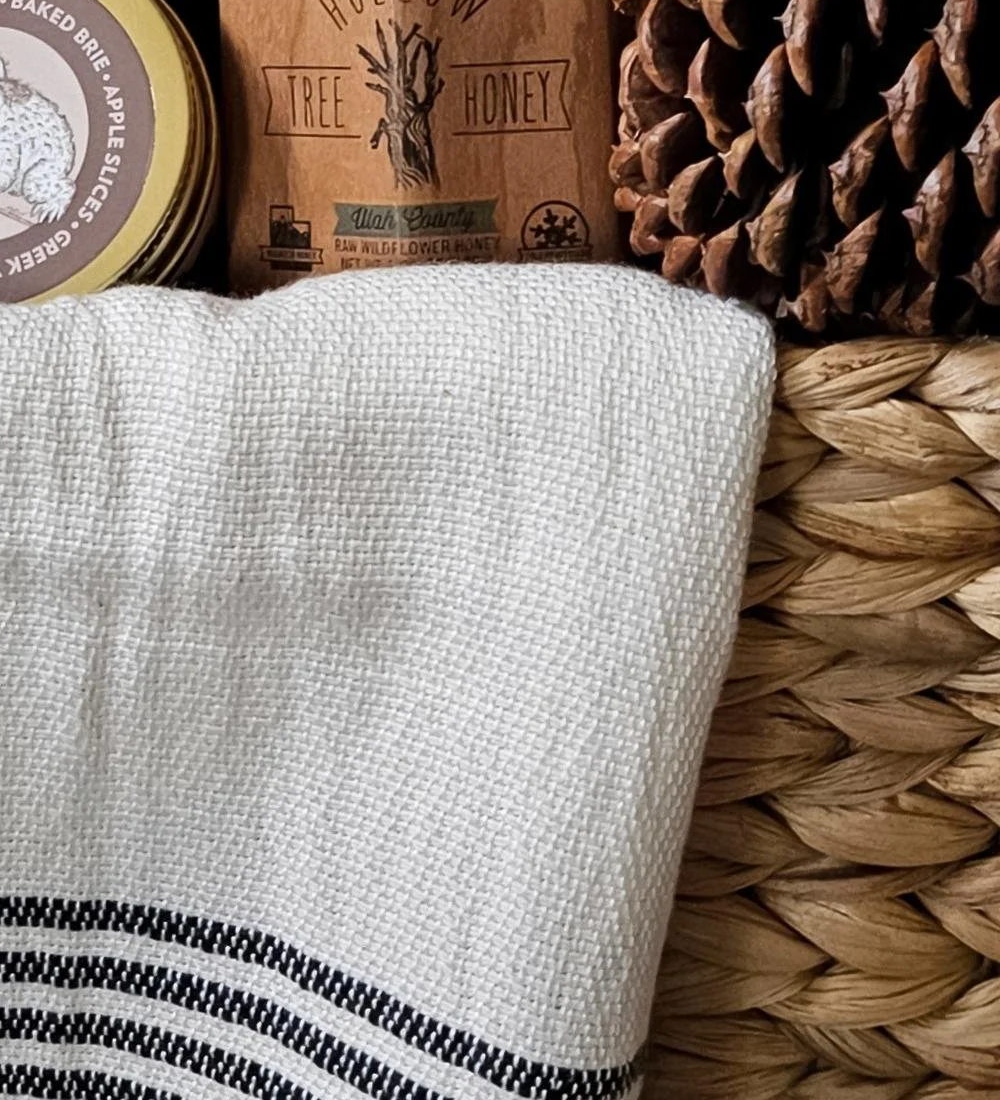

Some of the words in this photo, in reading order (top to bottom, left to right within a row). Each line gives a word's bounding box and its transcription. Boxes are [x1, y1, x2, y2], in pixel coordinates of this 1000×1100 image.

[72, 27, 111, 73] BRIE
[102, 85, 126, 149] APPLE
[287, 74, 346, 129] TREE
[464, 69, 551, 127] HONEY
[77, 153, 122, 224] SLICES
[351, 207, 398, 230] Utah
[402, 205, 476, 234] County
[4, 229, 72, 277] GREEK
[334, 237, 358, 253] RAW
[360, 239, 451, 256] WILDFLOWER
[455, 235, 501, 253] HONEY
